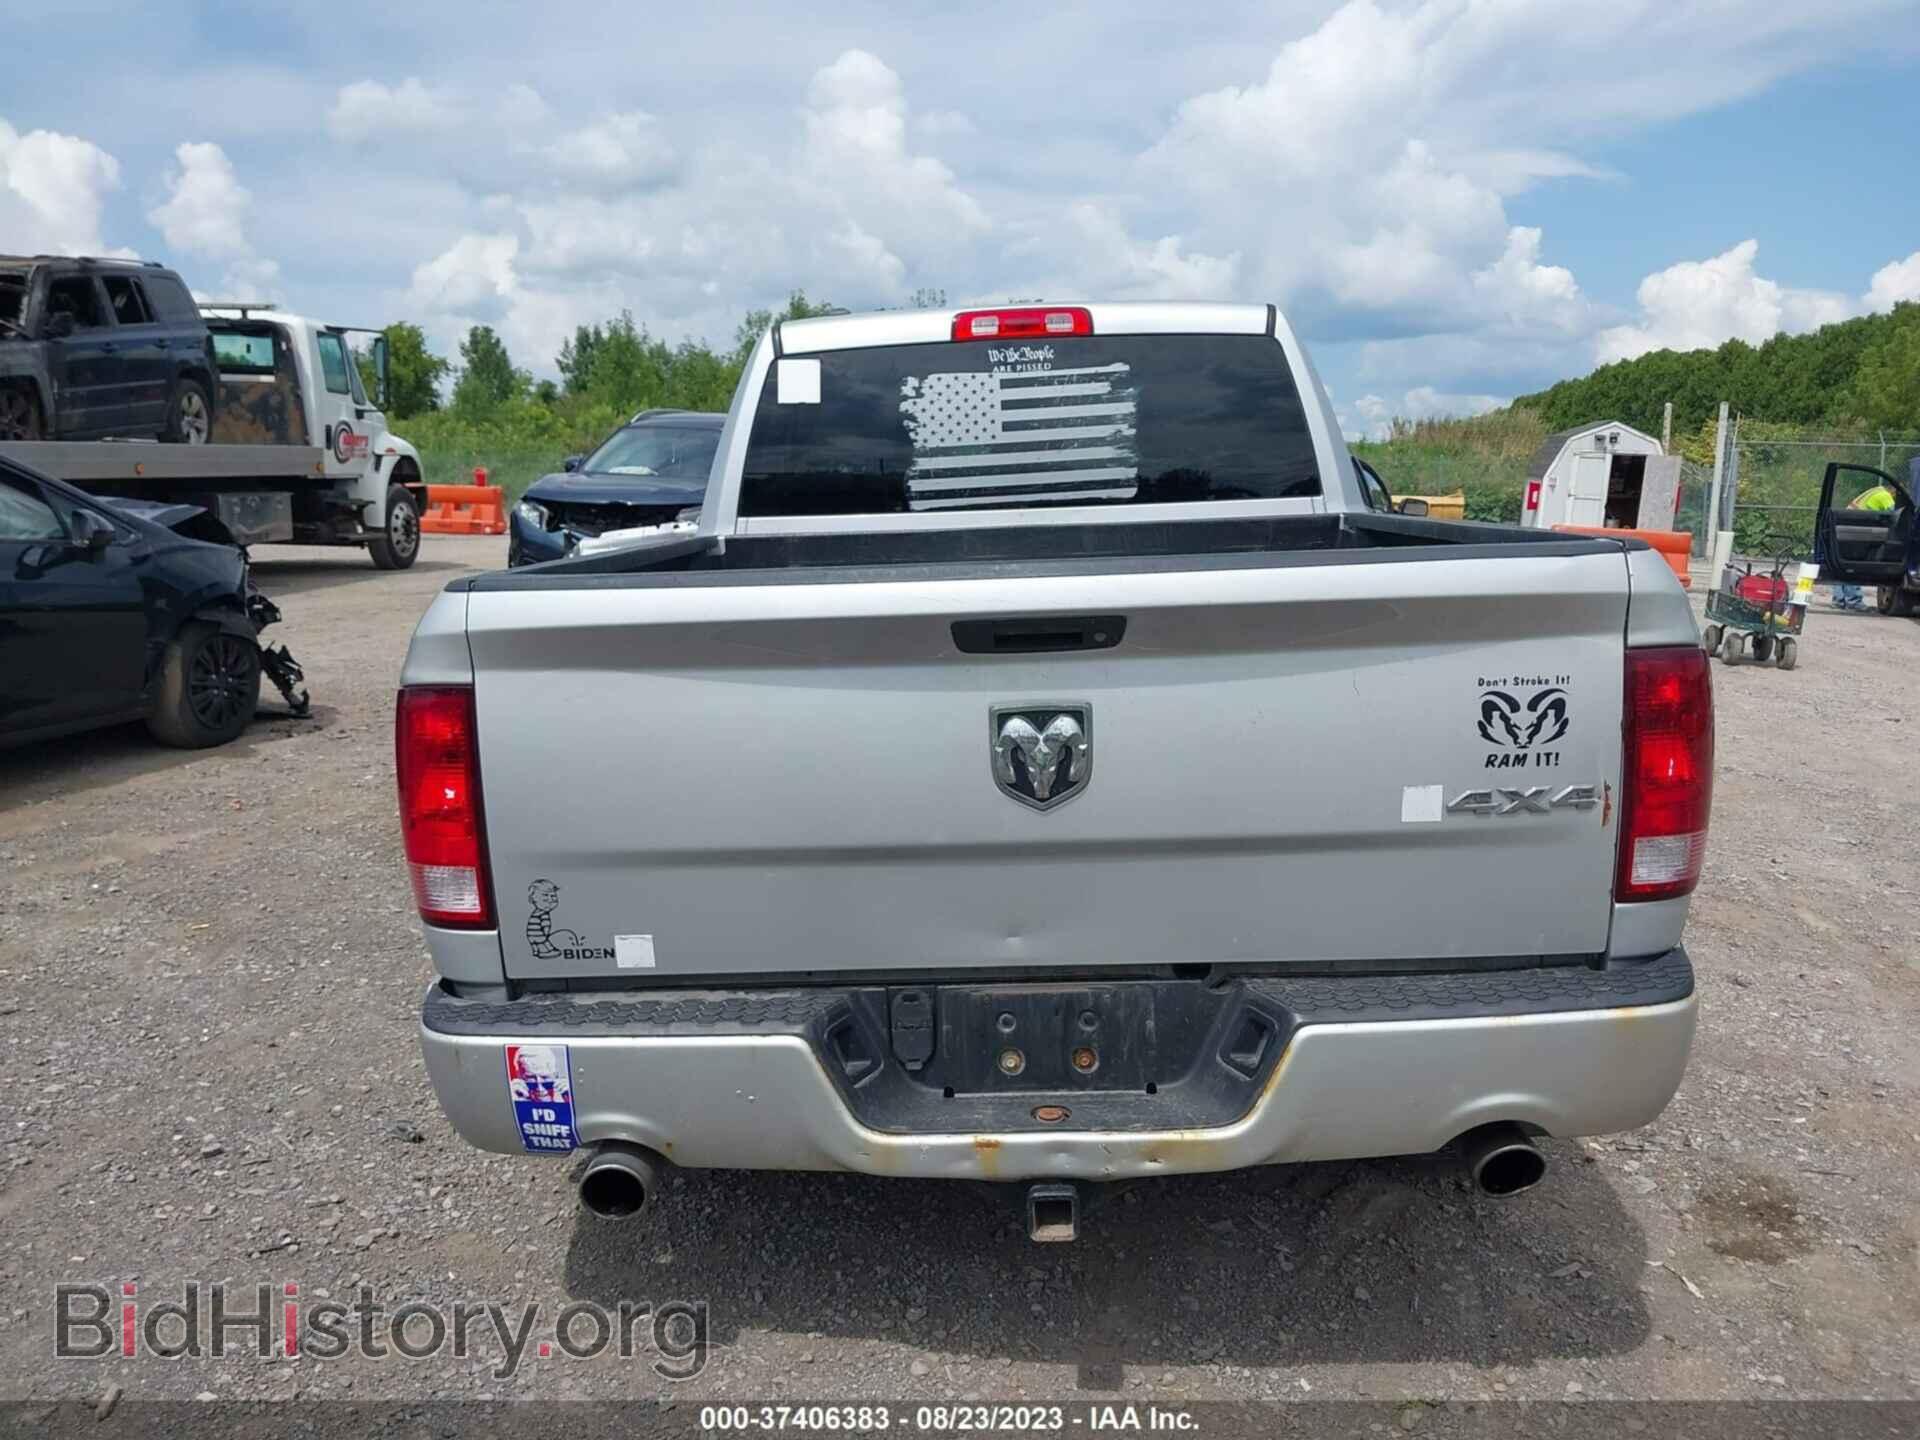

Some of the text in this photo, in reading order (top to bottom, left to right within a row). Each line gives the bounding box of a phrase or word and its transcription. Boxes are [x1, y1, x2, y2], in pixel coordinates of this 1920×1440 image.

[992, 362, 1052, 374] ARE PISSED
[1478, 675, 1570, 687] Don't Stroke It!
[1485, 752, 1560, 768] RAM IT!
[563, 948, 616, 960] BIDEN
[532, 1108, 556, 1122] I'D
[523, 1123, 570, 1137] SNIFF
[529, 1136, 571, 1149] THAT
